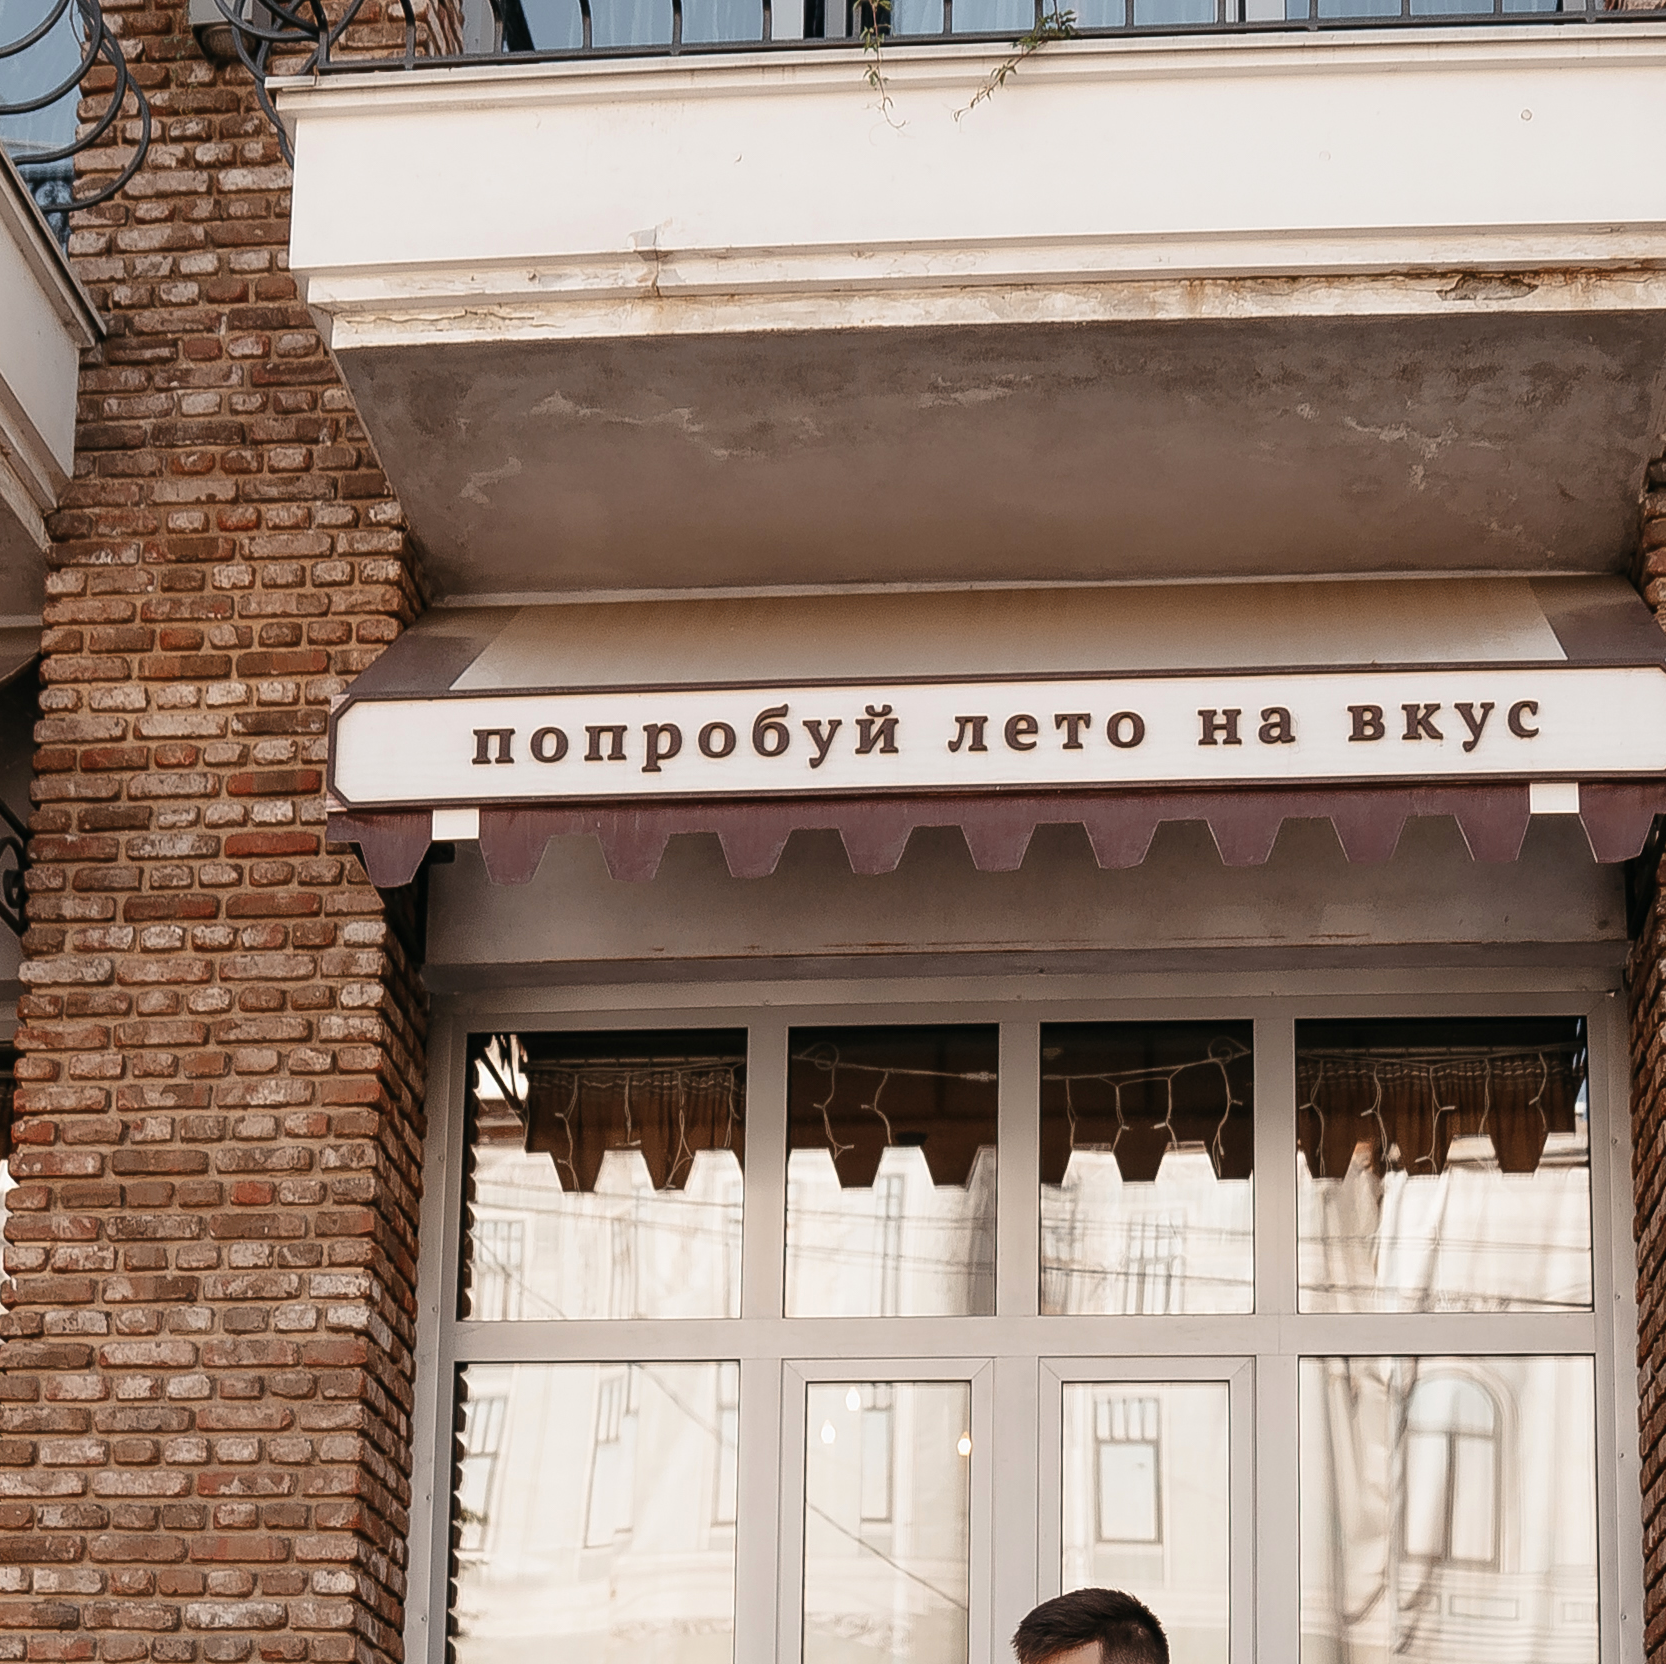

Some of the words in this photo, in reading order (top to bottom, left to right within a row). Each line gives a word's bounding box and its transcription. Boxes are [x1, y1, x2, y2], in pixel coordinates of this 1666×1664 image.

[470, 703, 901, 773] попробуй
[946, 711, 1147, 753] лето
[1196, 706, 1297, 746] на
[1345, 700, 1541, 757] вкус
